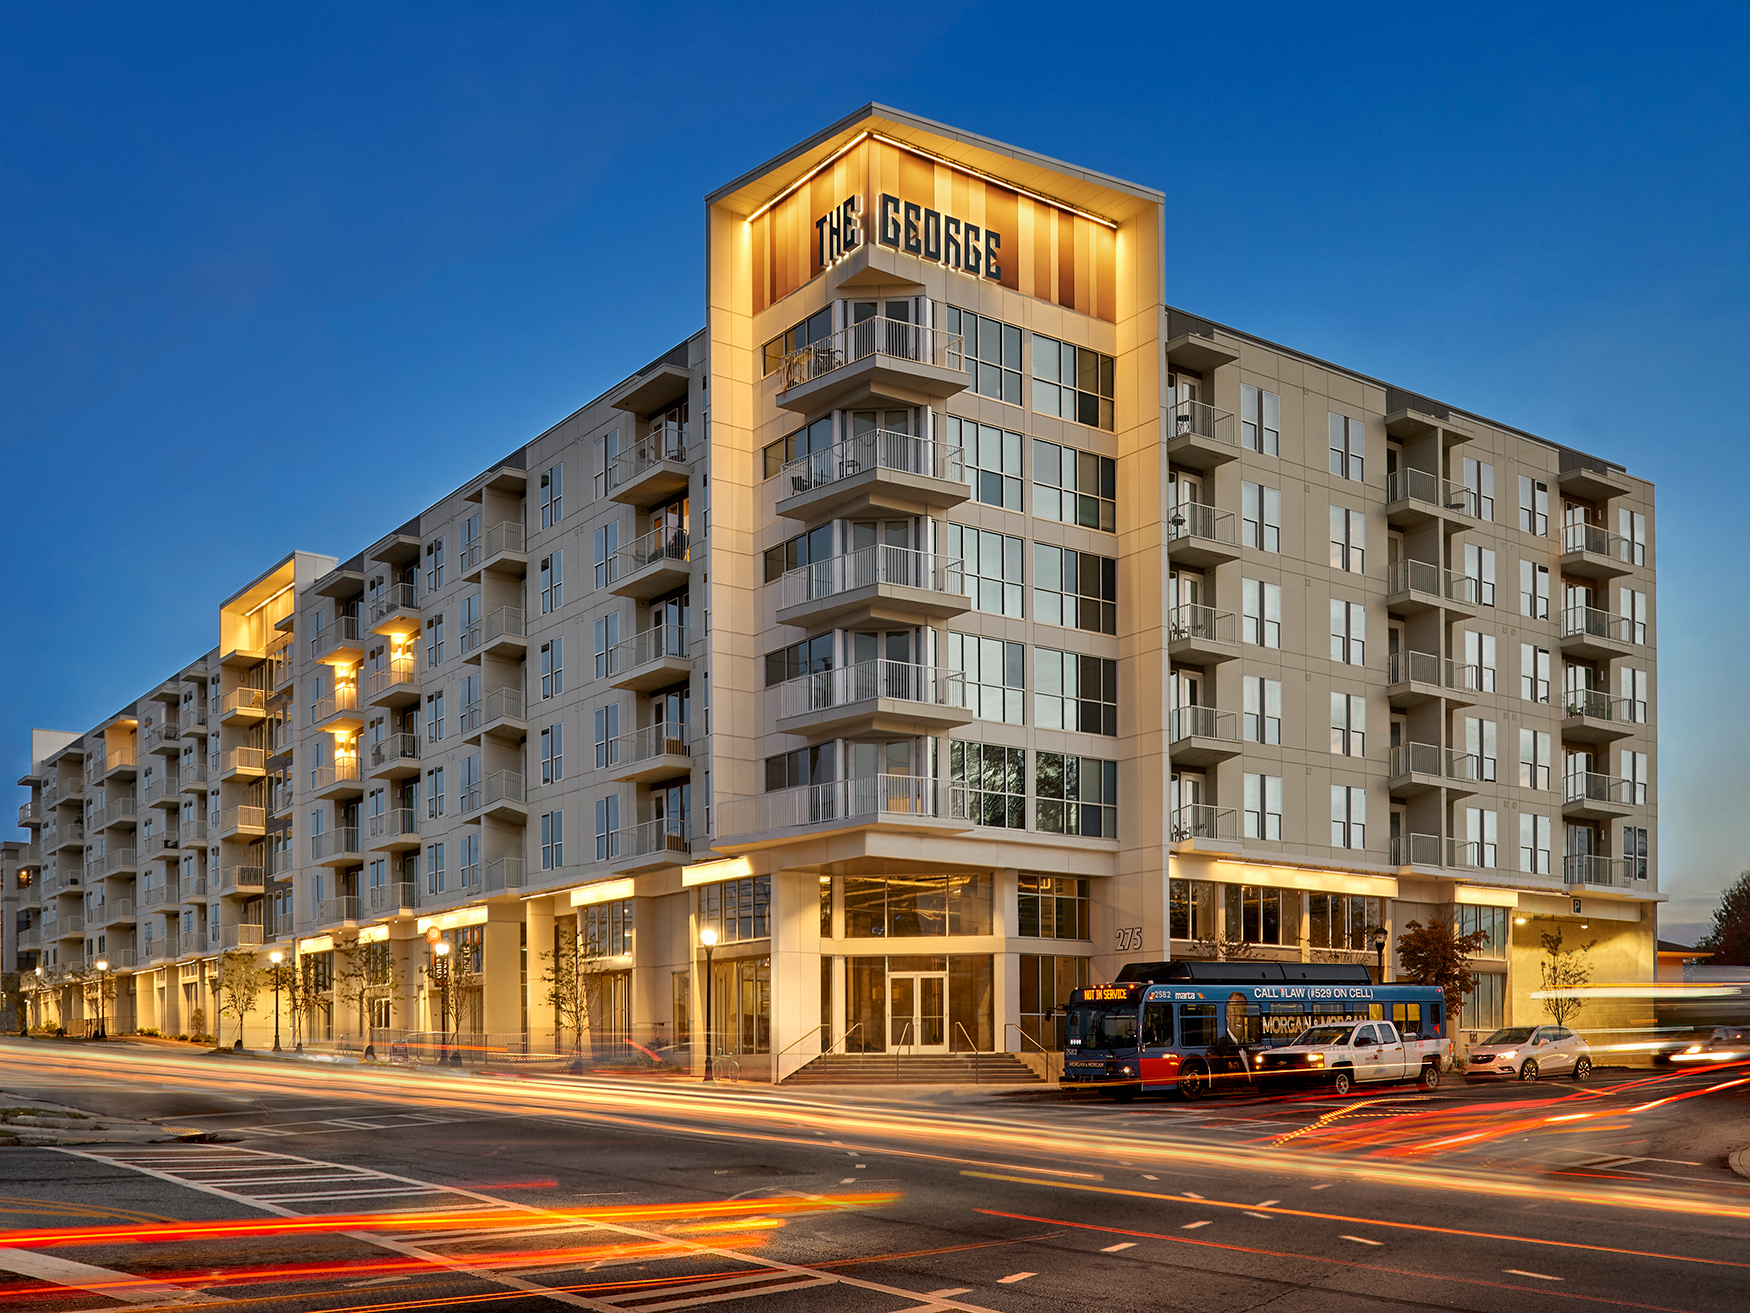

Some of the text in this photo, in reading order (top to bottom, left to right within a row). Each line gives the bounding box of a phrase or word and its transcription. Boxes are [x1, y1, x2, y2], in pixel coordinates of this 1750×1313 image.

[816, 193, 1001, 283] THE GEORGE
[1115, 927, 1142, 951] 275
[1084, 989, 1128, 1000] NOT IN SERVICE
[1254, 988, 1279, 998] CALL
[1333, 988, 1347, 998] ON
[1349, 988, 1374, 999] CELL)
[1262, 1016, 1311, 1034] MORGAN
